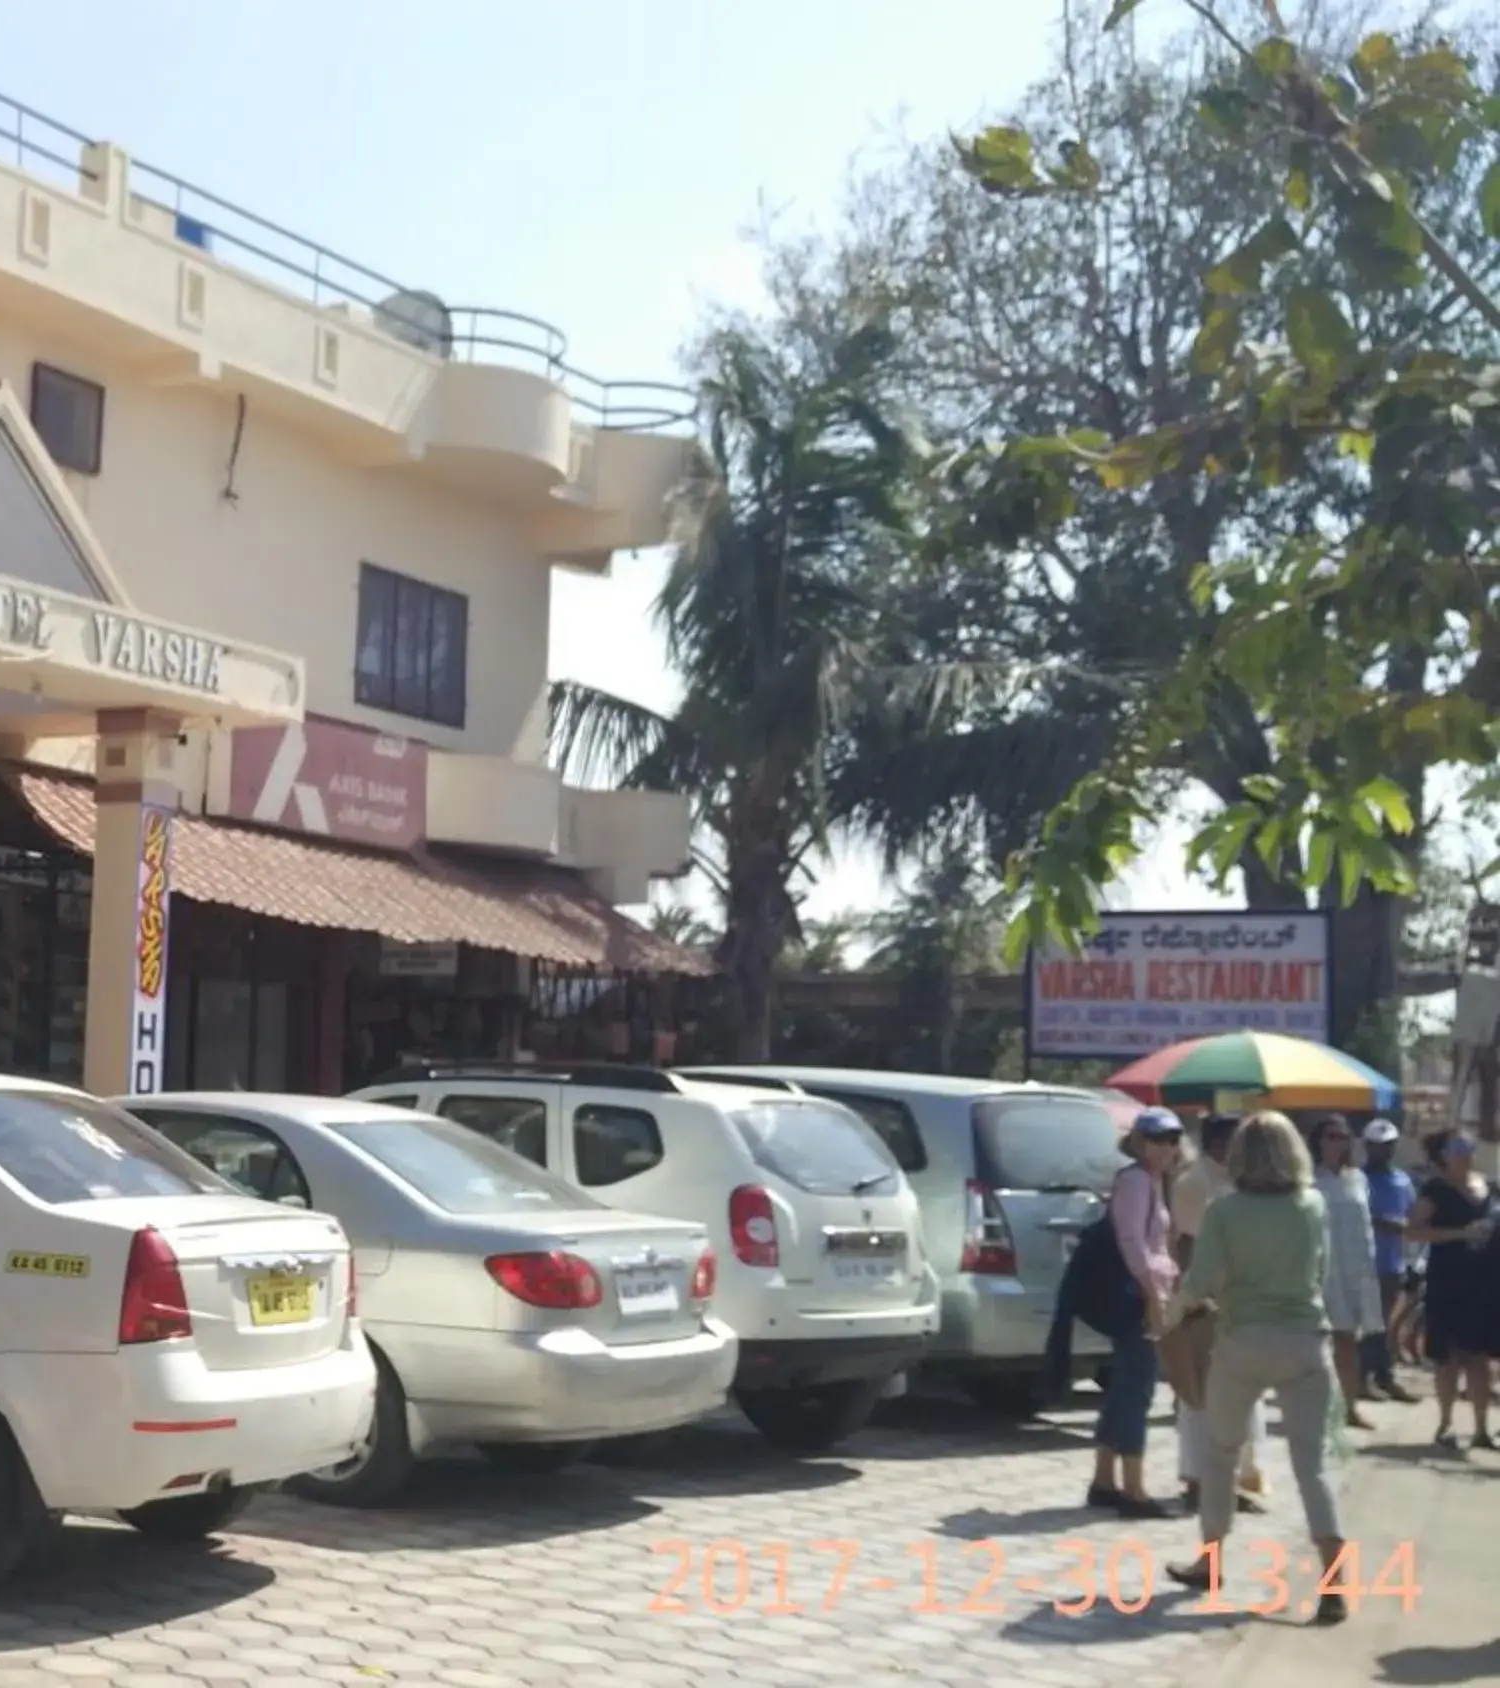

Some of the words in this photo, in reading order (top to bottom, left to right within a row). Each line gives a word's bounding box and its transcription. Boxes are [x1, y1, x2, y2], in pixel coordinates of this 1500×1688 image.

[92, 612, 226, 693] VARSHA
[1039, 958, 1136, 1001] VARSHA
[1145, 958, 1322, 1001] RESTAURANT
